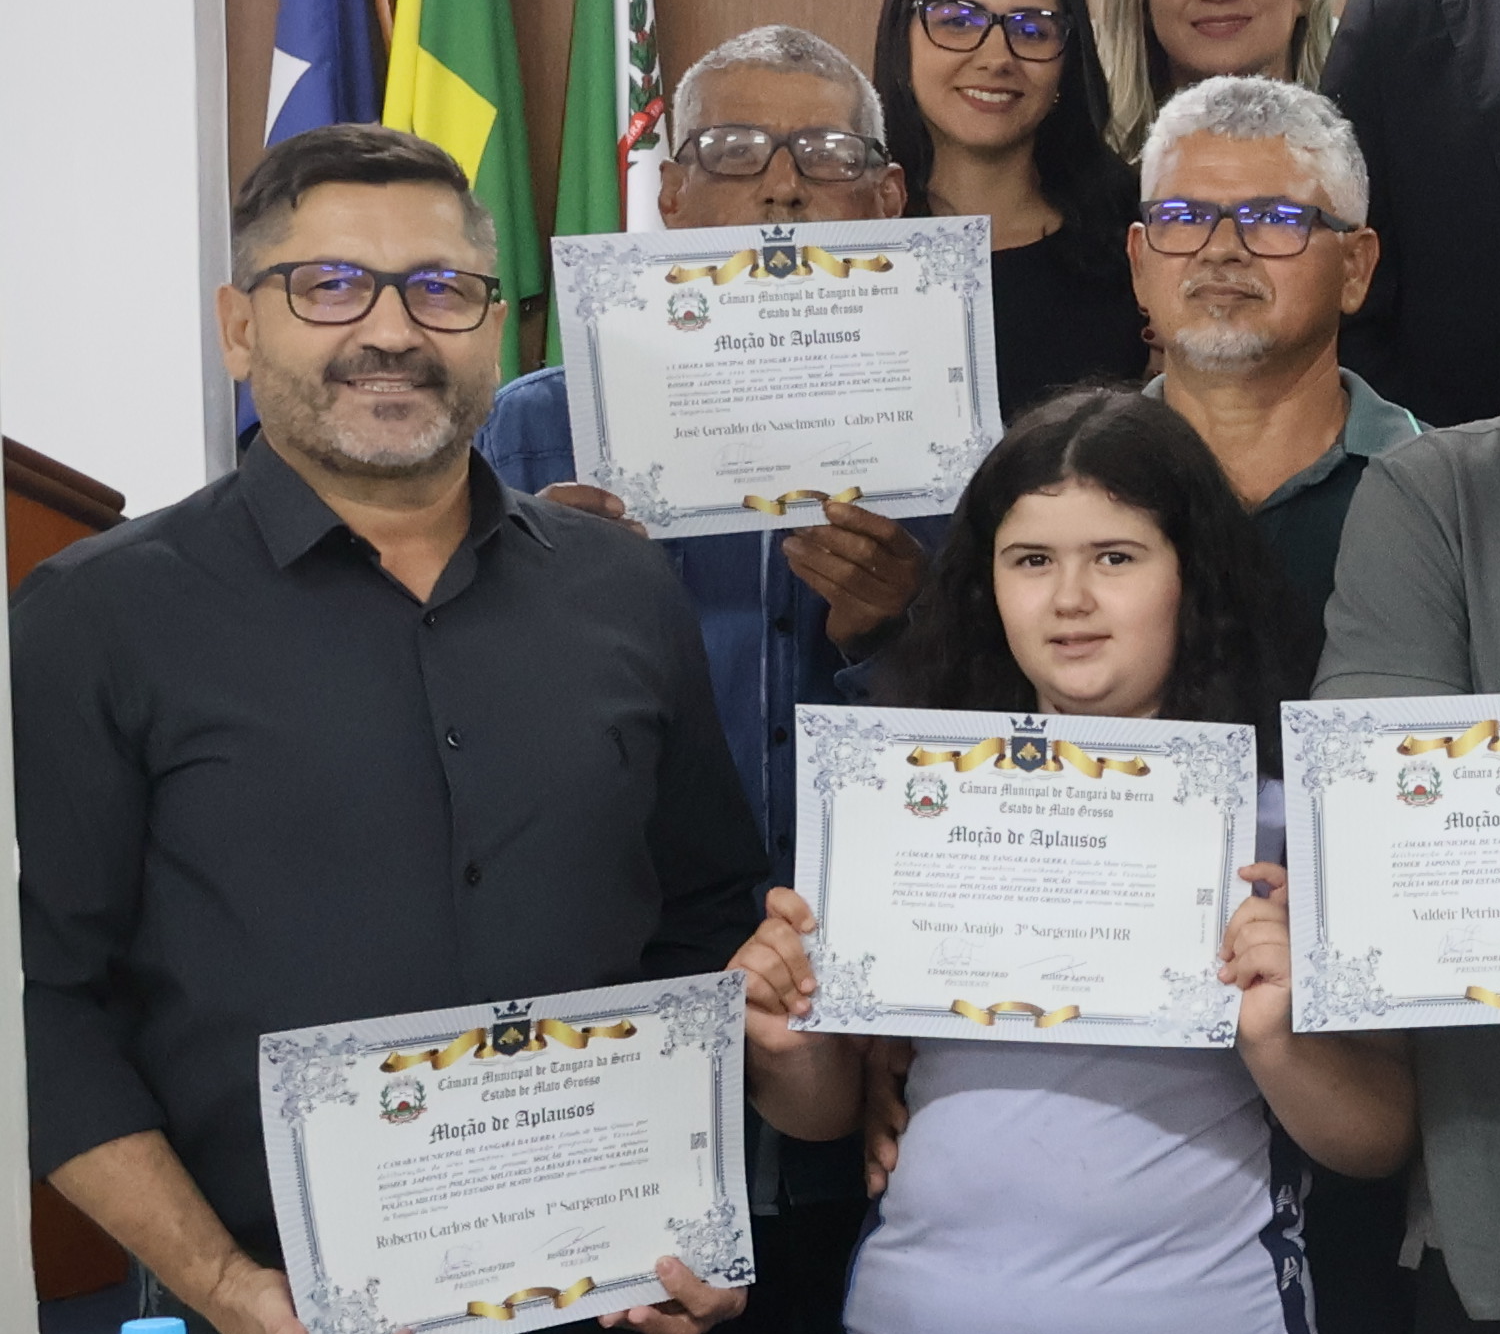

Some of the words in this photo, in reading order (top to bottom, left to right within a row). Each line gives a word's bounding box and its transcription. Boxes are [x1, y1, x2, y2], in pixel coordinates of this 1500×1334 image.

[713, 331, 765, 354] Moção
[768, 332, 786, 348] de
[790, 328, 861, 348] Aplausos
[1444, 809, 1500, 832] Moção
[946, 825, 1002, 848] Moção
[1007, 828, 1025, 846] de
[1029, 828, 1108, 850] Aplausos
[1412, 908, 1455, 921] Valdeir
[911, 919, 959, 933] Silvano
[963, 922, 1004, 938] Araújo
[1031, 924, 1088, 940] Sargento
[1089, 926, 1110, 940] PM
[1112, 927, 1131, 941] RR
[428, 1118, 487, 1145] Moção
[491, 1115, 510, 1132] de
[514, 1101, 595, 1129] Aplausos
[375, 1230, 428, 1250] Roberto
[429, 1220, 472, 1239] Carlos
[473, 1216, 490, 1229] de
[559, 1193, 617, 1212] Sargento
[619, 1185, 640, 1202] PM
[642, 1182, 660, 1198] RR
